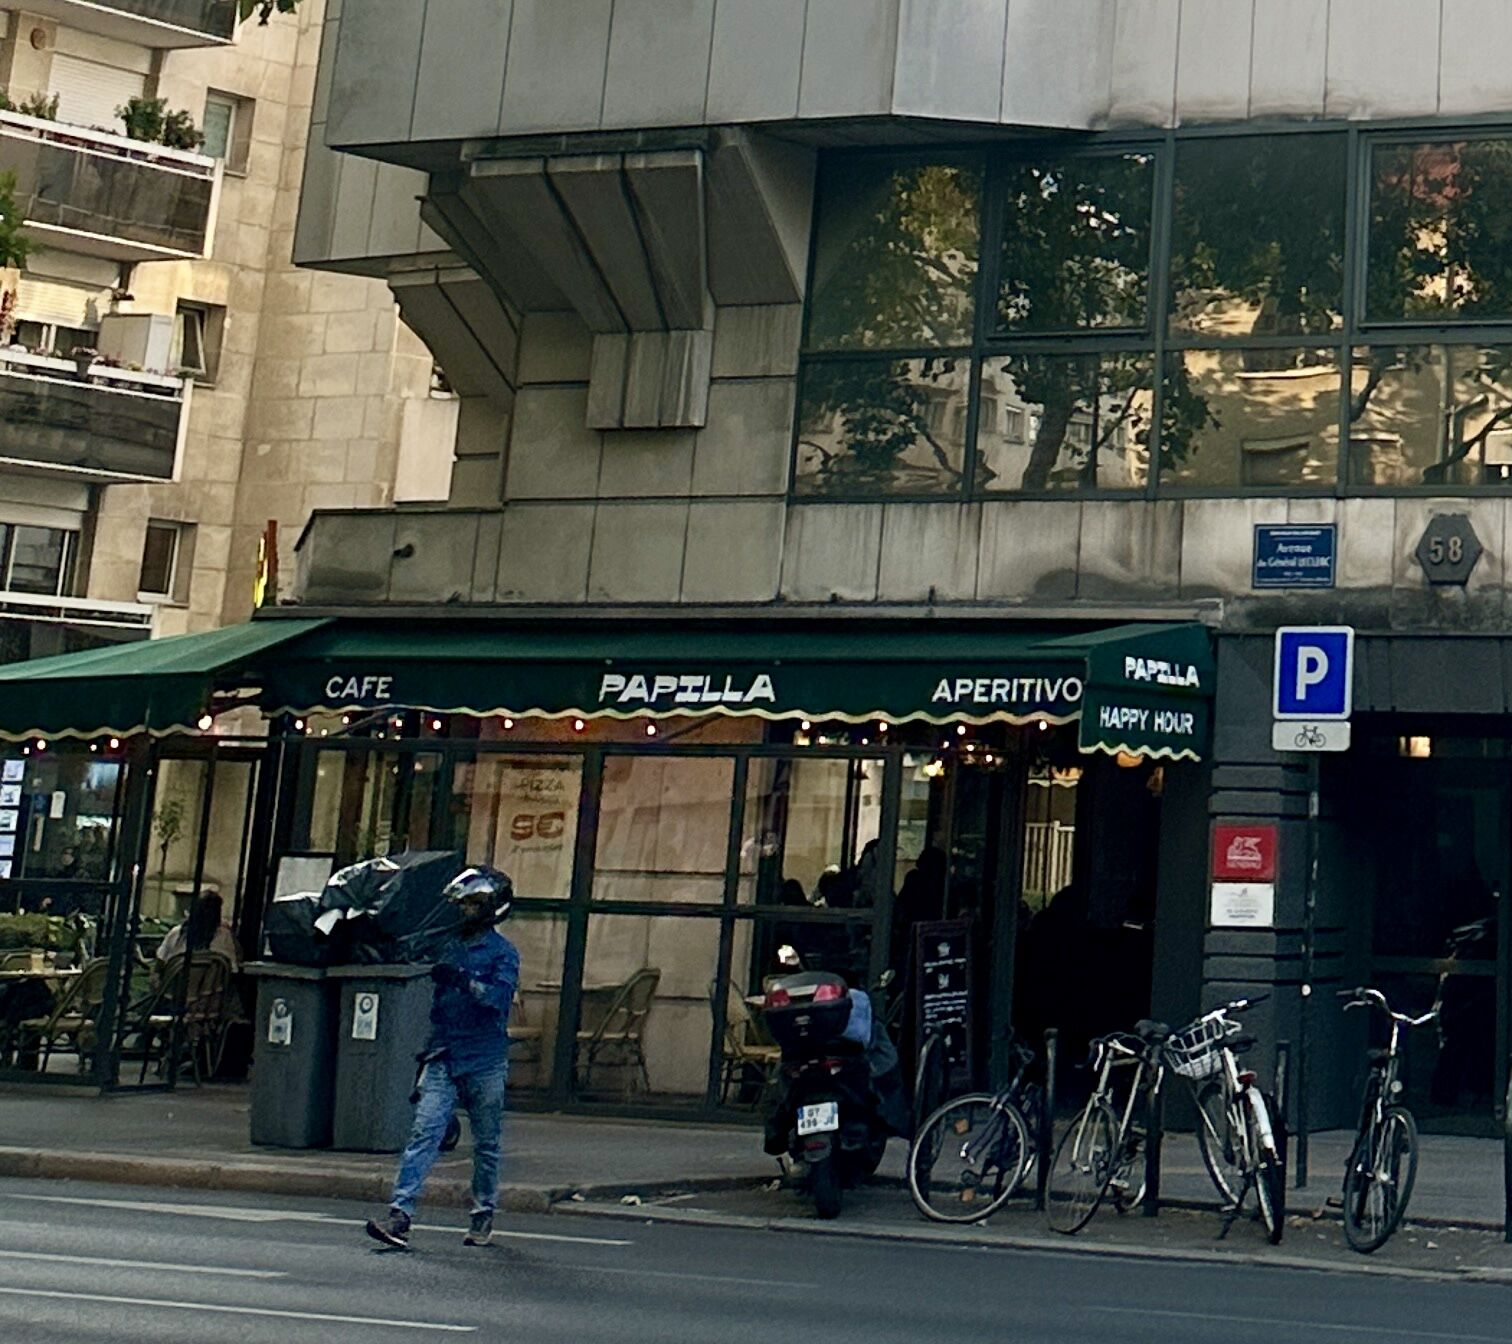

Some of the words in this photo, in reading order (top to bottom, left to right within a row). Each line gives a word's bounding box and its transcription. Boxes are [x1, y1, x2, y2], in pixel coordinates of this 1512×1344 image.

[1429, 536, 1463, 564] 58
[1124, 655, 1200, 688] PAPILLA
[1296, 645, 1329, 700] P
[325, 675, 393, 699] CAFE
[598, 673, 777, 703] PAPILLA
[931, 677, 1083, 703] APERITIVO
[1100, 705, 1149, 731] HAPPY
[1153, 710, 1194, 735] HOUR
